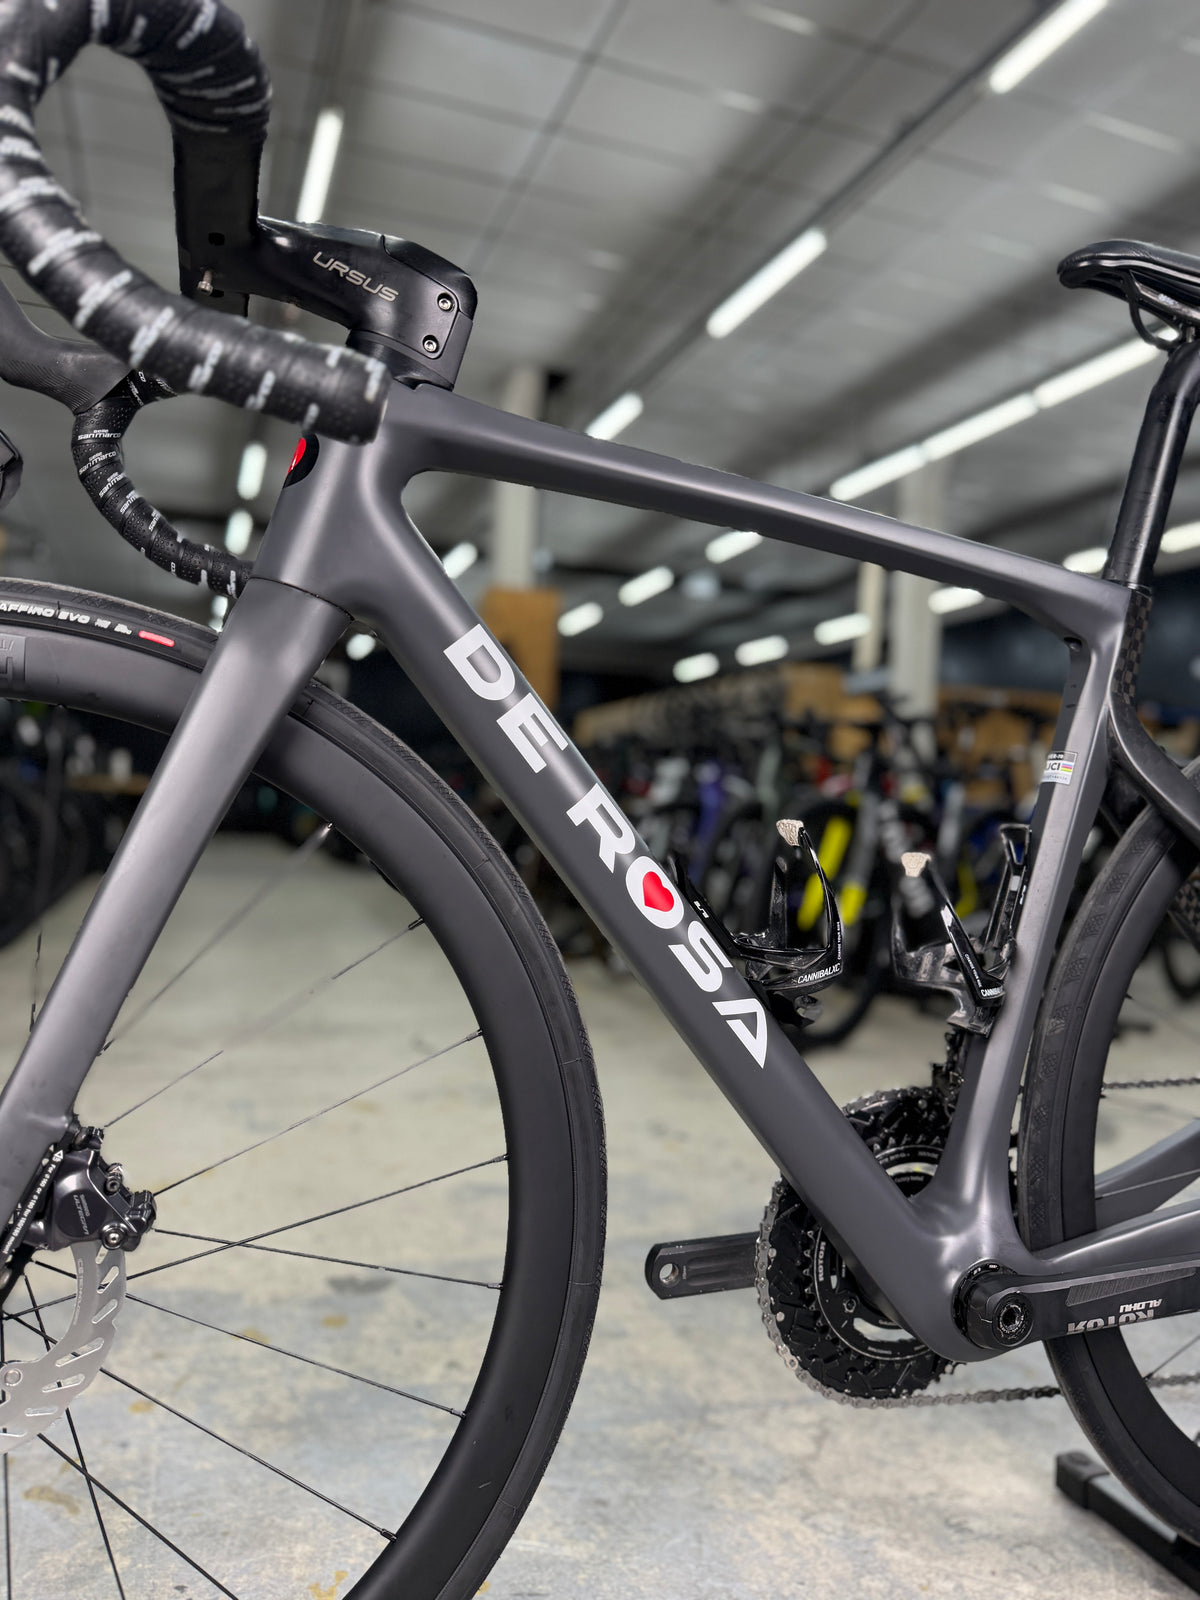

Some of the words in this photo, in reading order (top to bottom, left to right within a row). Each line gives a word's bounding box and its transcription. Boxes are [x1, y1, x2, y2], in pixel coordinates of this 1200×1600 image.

[313, 251, 399, 302] URSUS
[57, 610, 91, 624] EVO
[443, 623, 568, 773] DE
[566, 783, 767, 1069] ROSA
